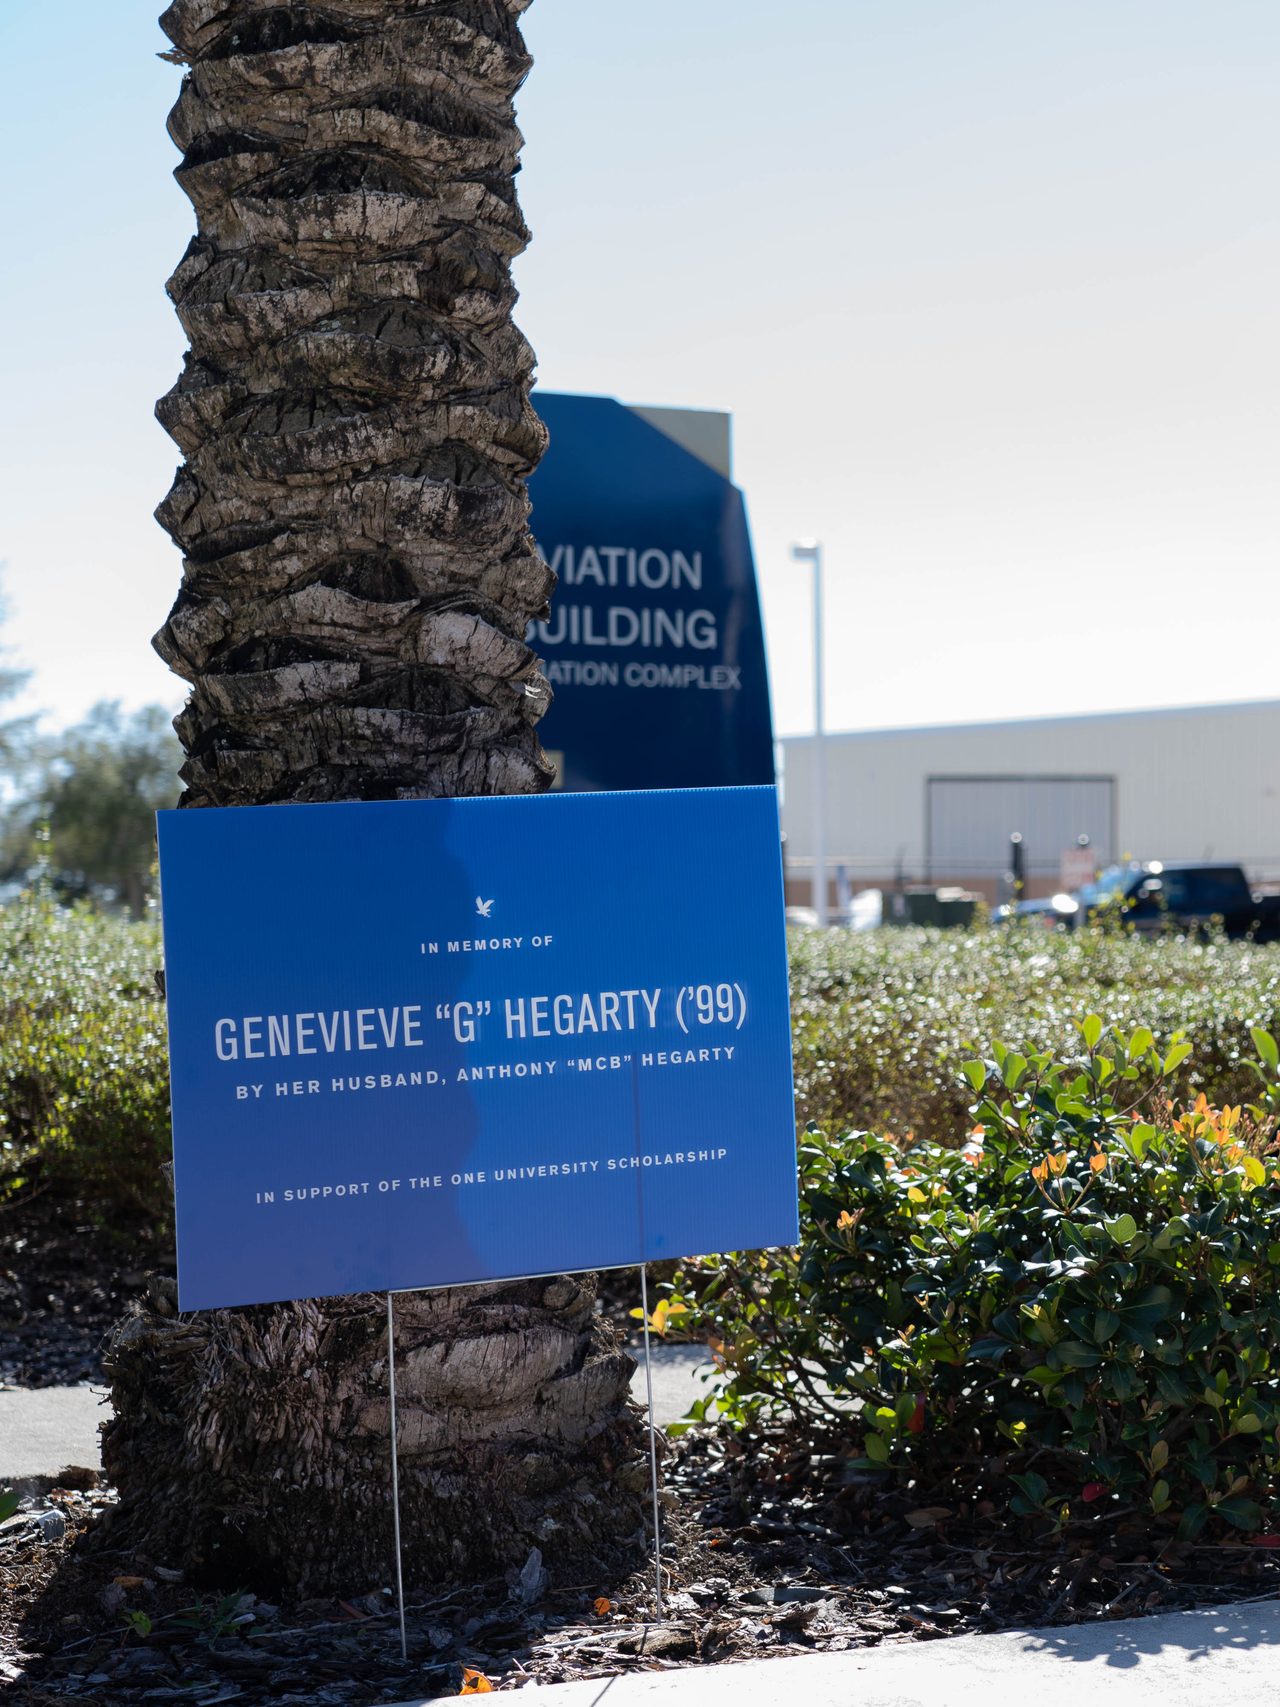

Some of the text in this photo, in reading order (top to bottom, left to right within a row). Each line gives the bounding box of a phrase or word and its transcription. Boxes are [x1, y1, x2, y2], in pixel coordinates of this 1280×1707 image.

[536, 544, 701, 590] VIATION
[541, 660, 742, 691] ATION COMPLEX
[420, 935, 553, 955] IN MEMORY OF
[214, 1004, 424, 1061] GENEVIEVE
[435, 1000, 492, 1044] “G”
[504, 987, 662, 1039] HEGARTY
[236, 1085, 264, 1100] BY
[275, 1079, 321, 1097] HER
[331, 1070, 446, 1092] HUSBAND,
[456, 1060, 557, 1082] ANTHONY
[641, 1046, 735, 1067] HEGARTY
[256, 1148, 727, 1204] IN SUPPORT OF THE ONE UNIVERSITY SCHOLARSHIP
